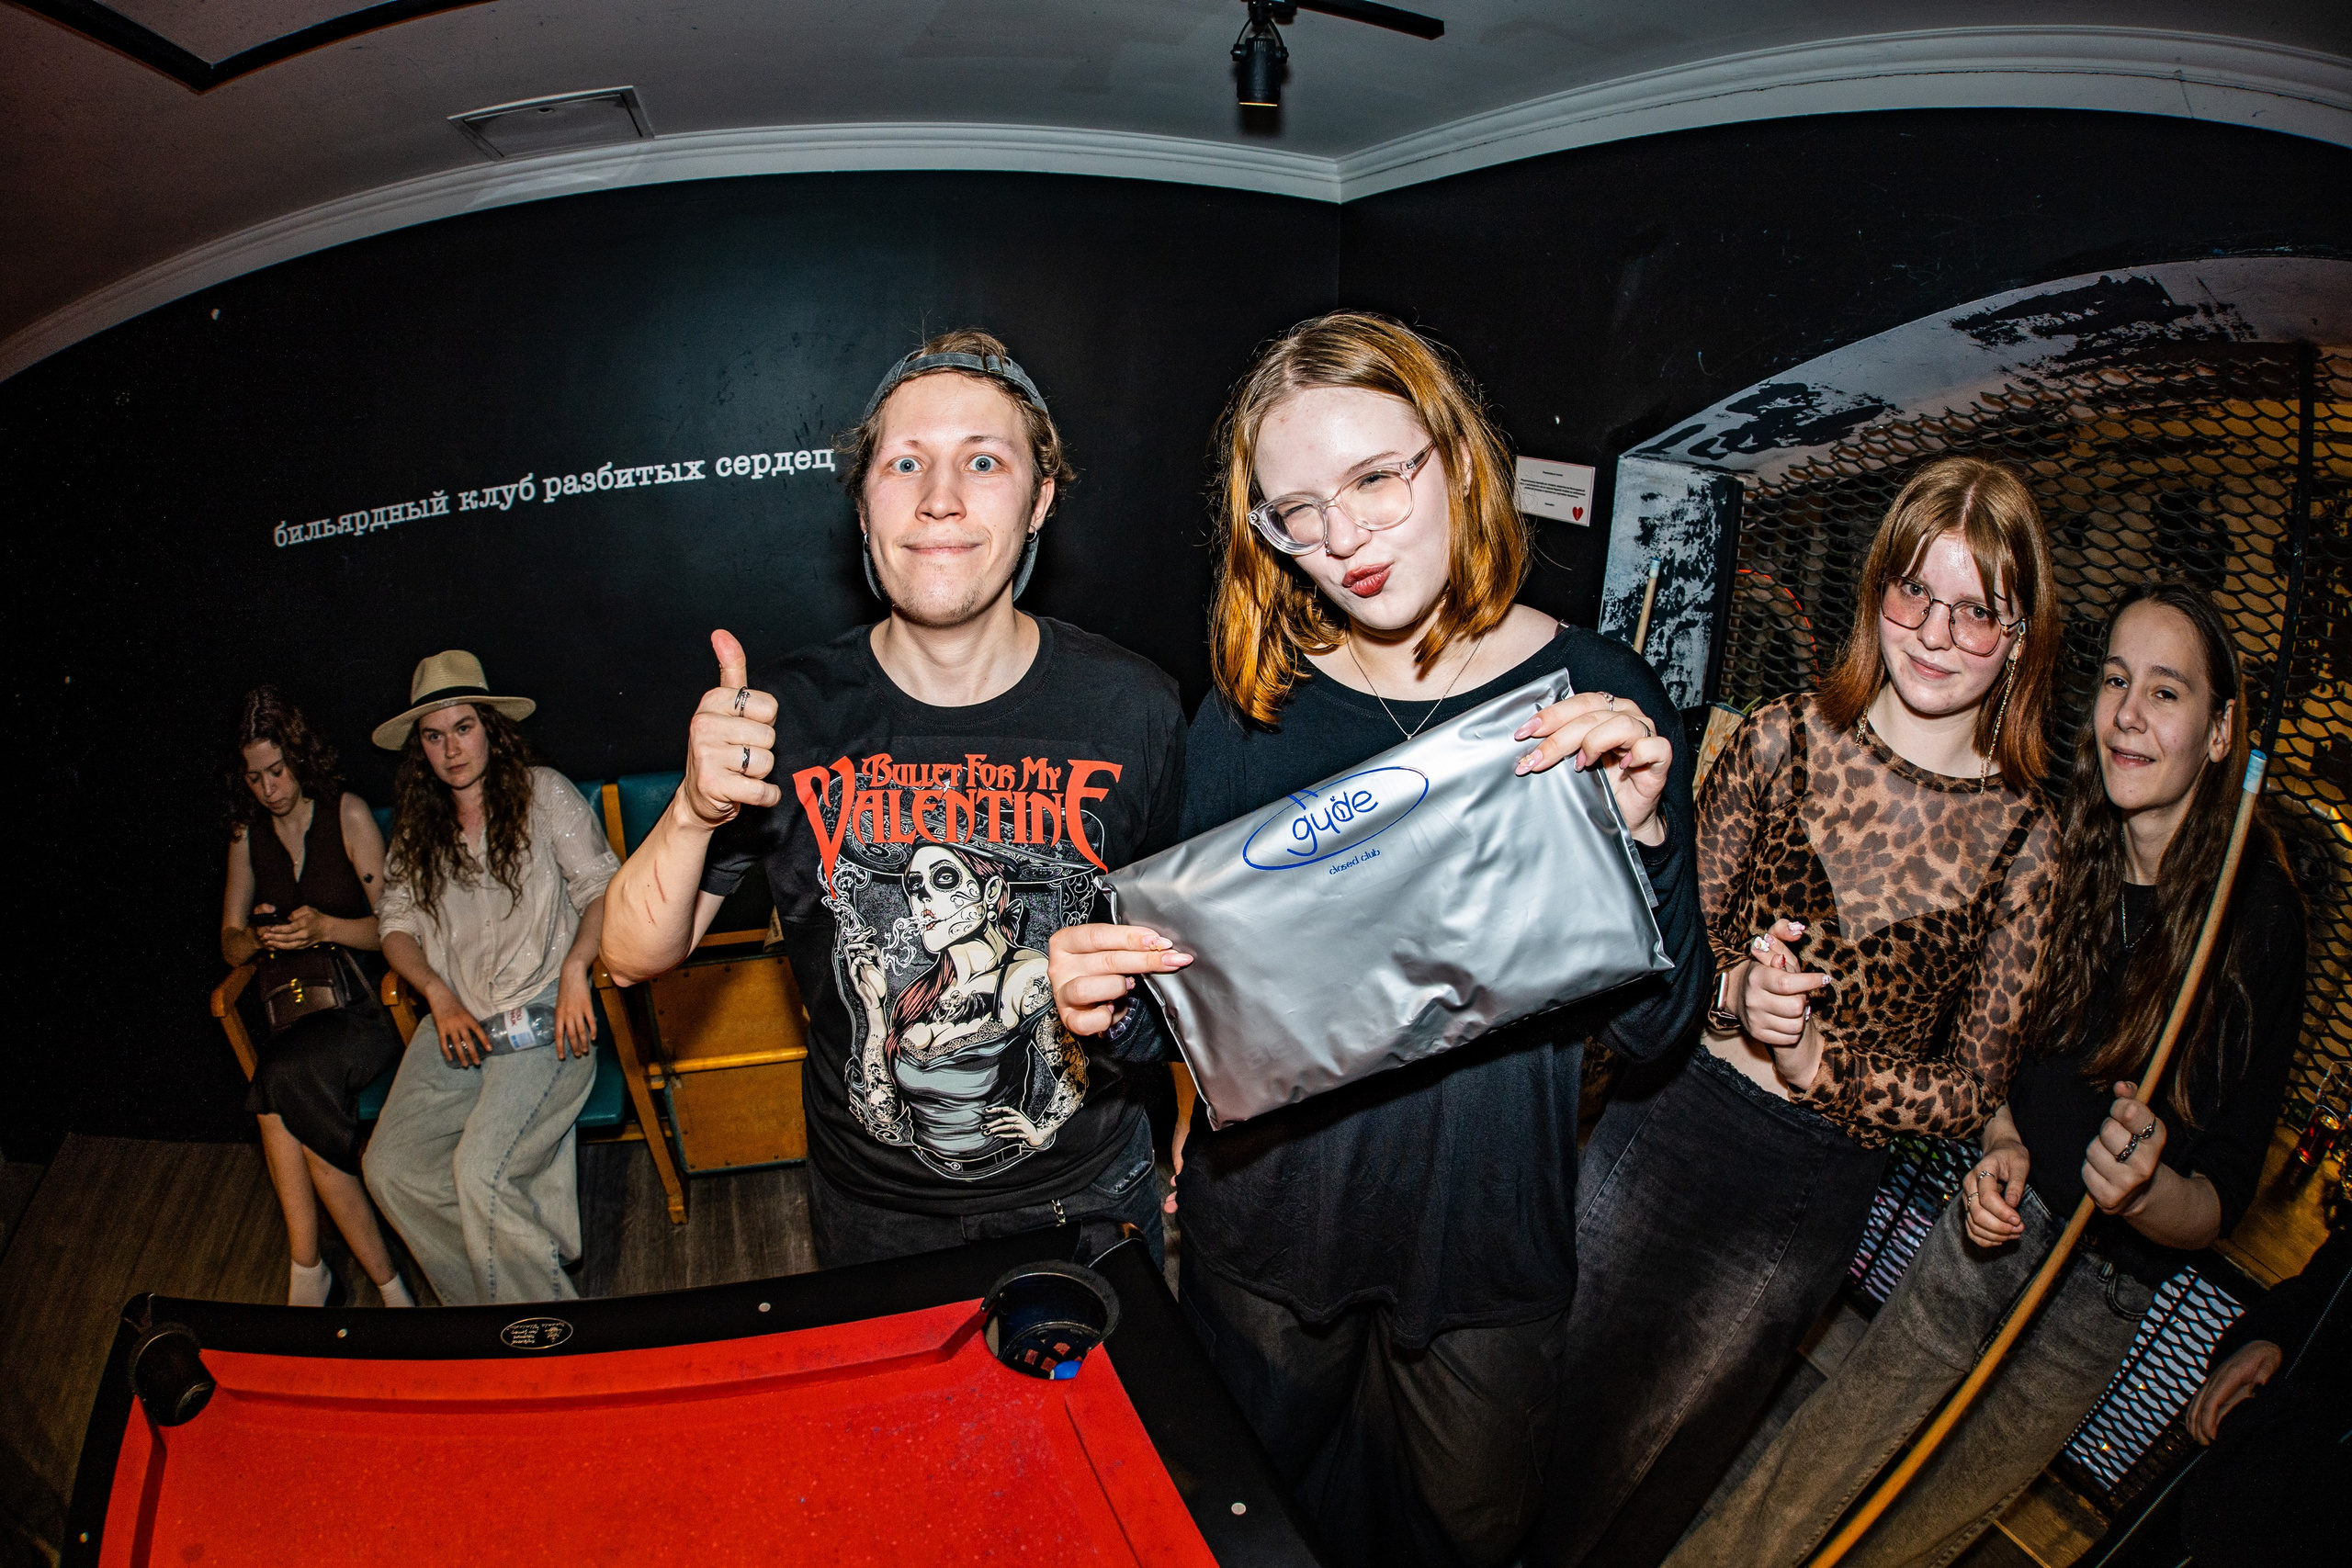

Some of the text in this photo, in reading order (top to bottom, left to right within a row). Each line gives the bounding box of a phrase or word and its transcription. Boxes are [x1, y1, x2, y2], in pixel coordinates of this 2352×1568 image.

[275, 447, 835, 547] бильярдный клуб разбитых сердец
[1329, 848, 1382, 875] closed club
